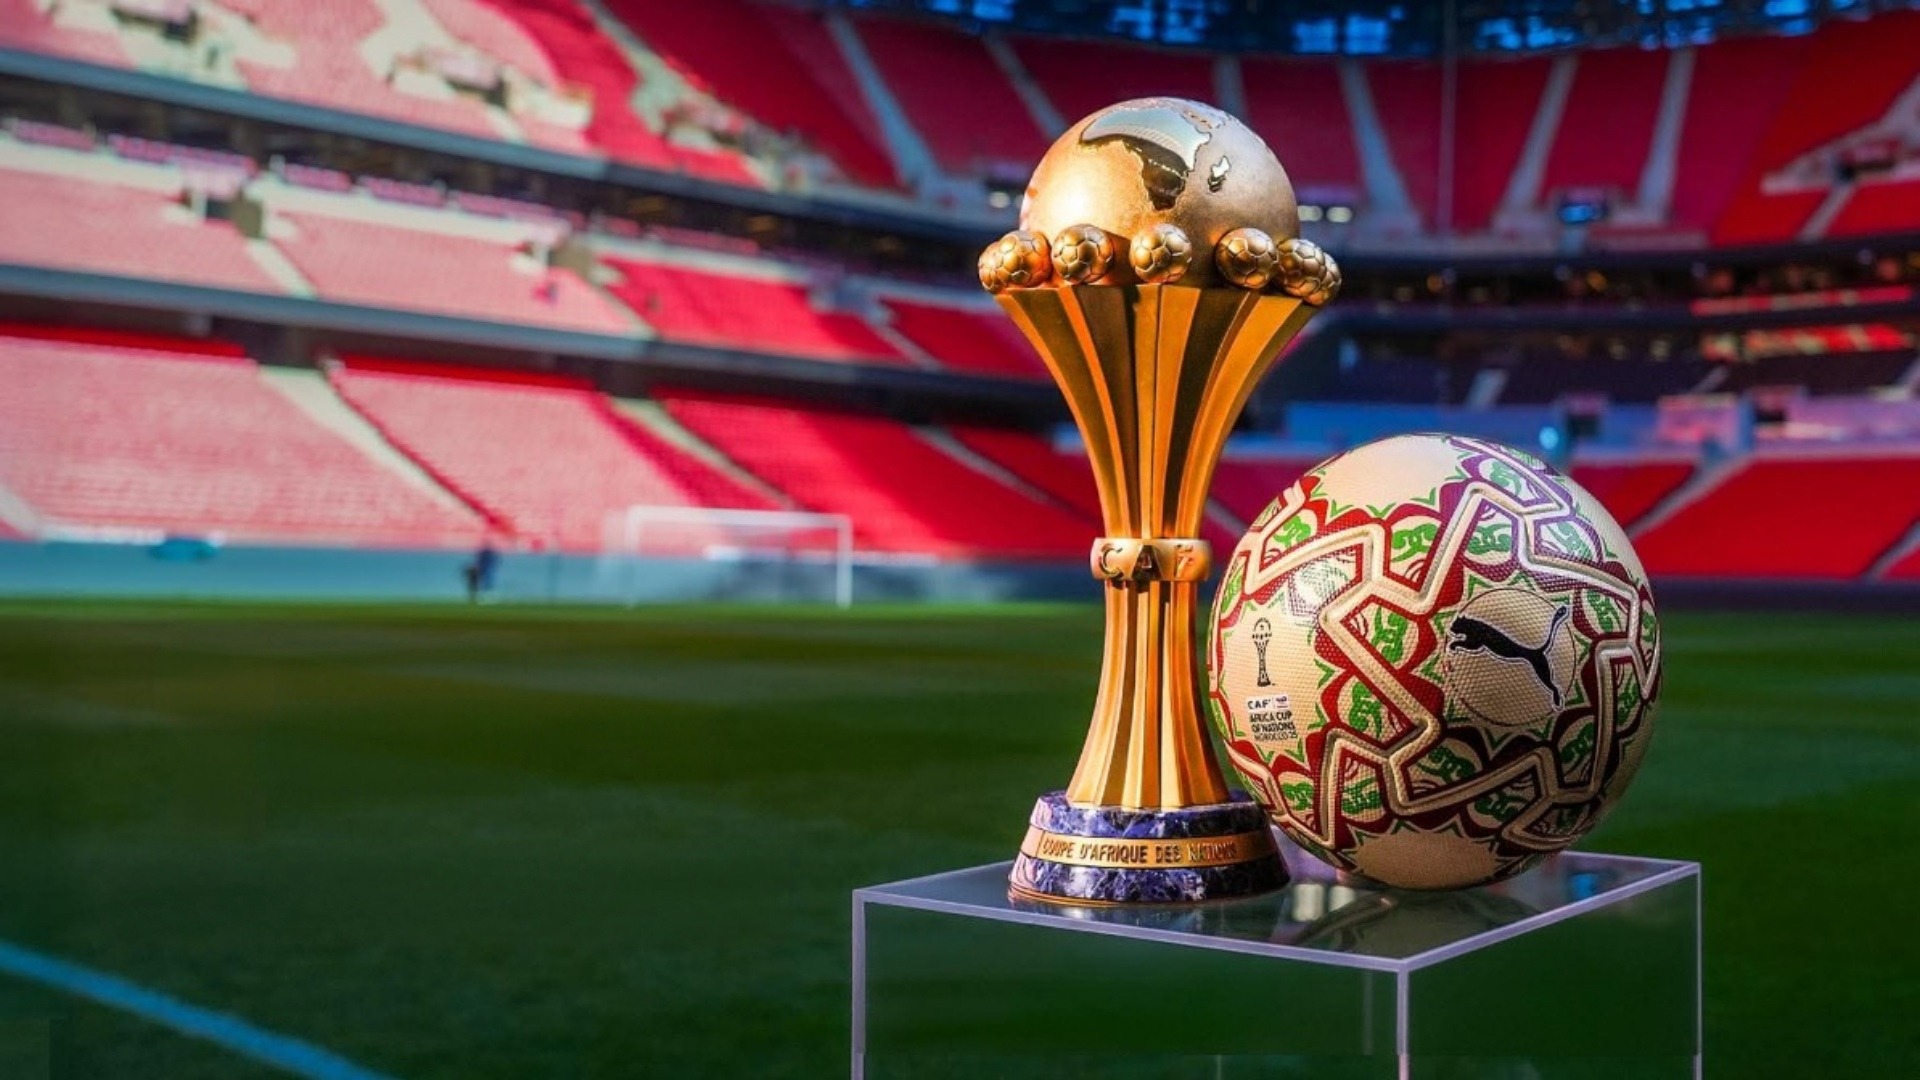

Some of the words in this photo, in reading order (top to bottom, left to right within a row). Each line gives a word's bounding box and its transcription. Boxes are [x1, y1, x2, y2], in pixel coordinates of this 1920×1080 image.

[1098, 543, 1194, 581] CAF
[1247, 699, 1269, 709] CAF
[1276, 710, 1292, 721] CUP
[1043, 838, 1075, 858] COUPE
[1080, 843, 1149, 864] D'AFRIQUE
[1155, 845, 1181, 863] DES
